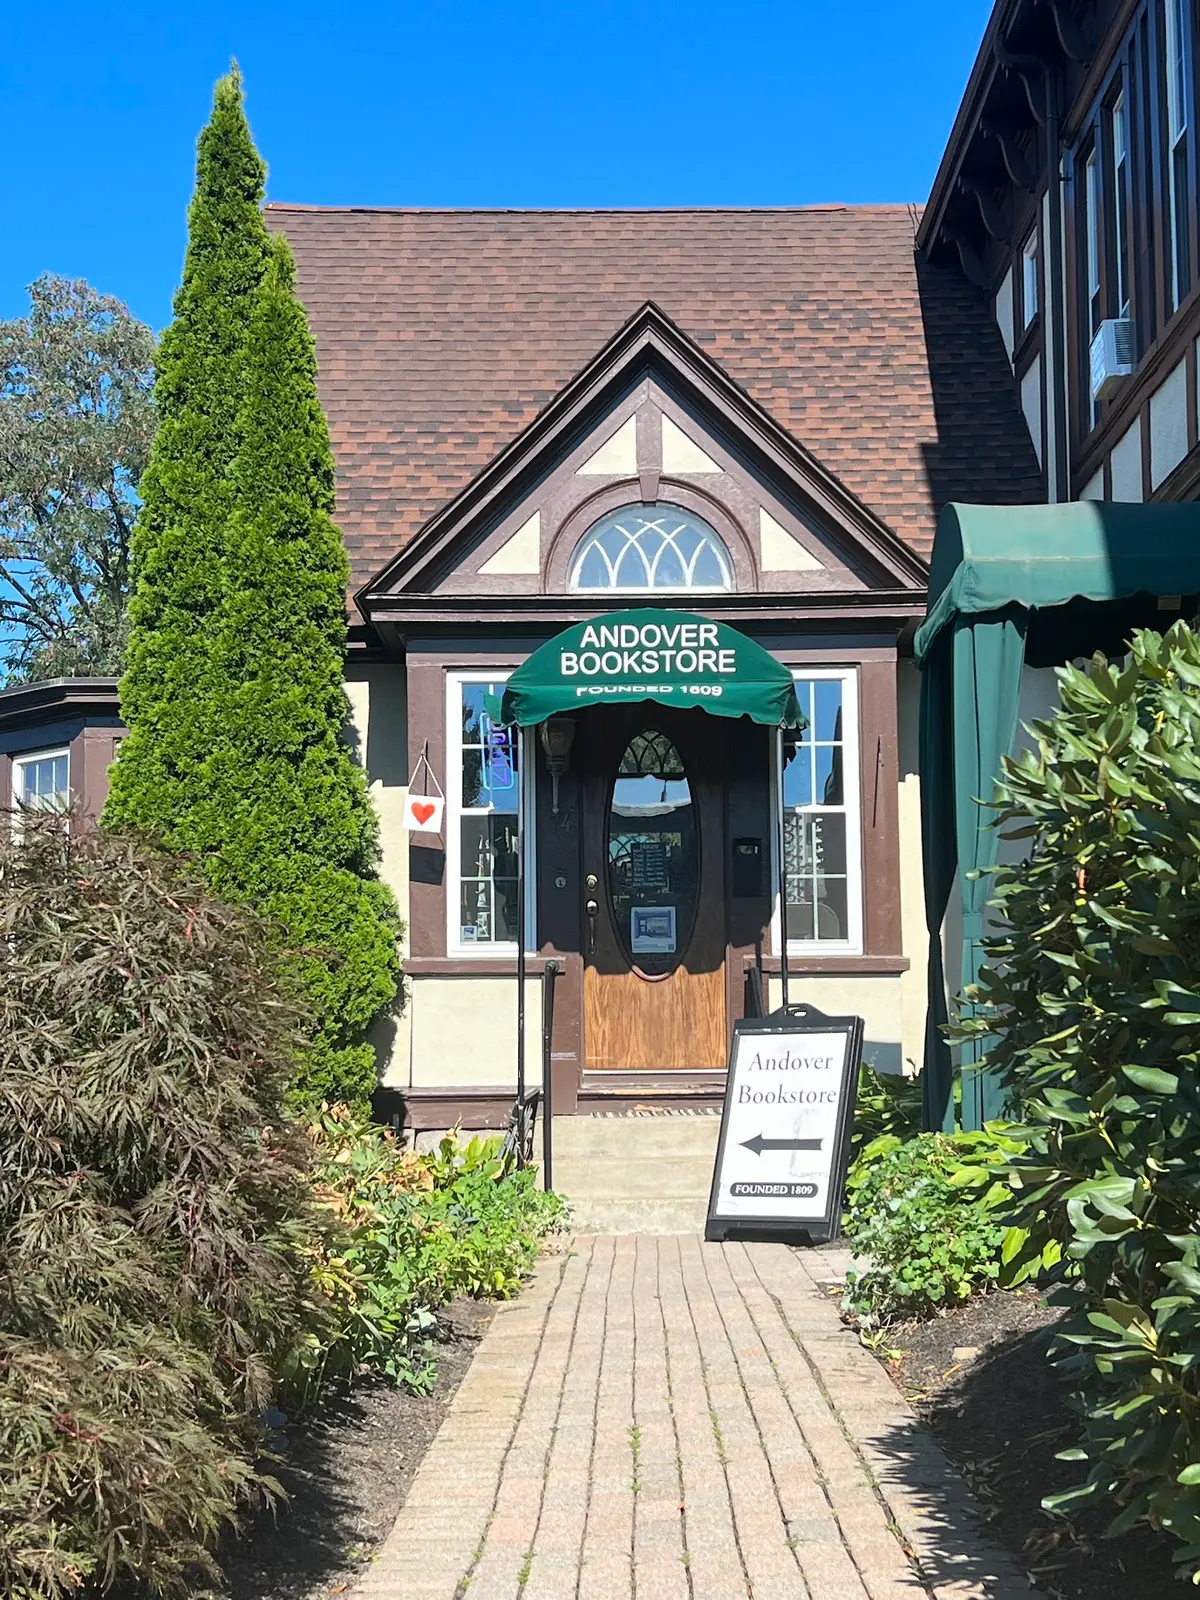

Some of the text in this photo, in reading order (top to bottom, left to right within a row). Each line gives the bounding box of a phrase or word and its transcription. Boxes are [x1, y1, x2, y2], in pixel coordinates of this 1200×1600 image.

[580, 624, 719, 648] ANDOVER
[561, 649, 736, 675] BOOKSTORE
[576, 685, 673, 696] FOUNDED
[748, 1050, 833, 1071] Andover
[738, 1084, 837, 1104] Bookstore
[735, 1184, 813, 1195] FOUNDED 1809
